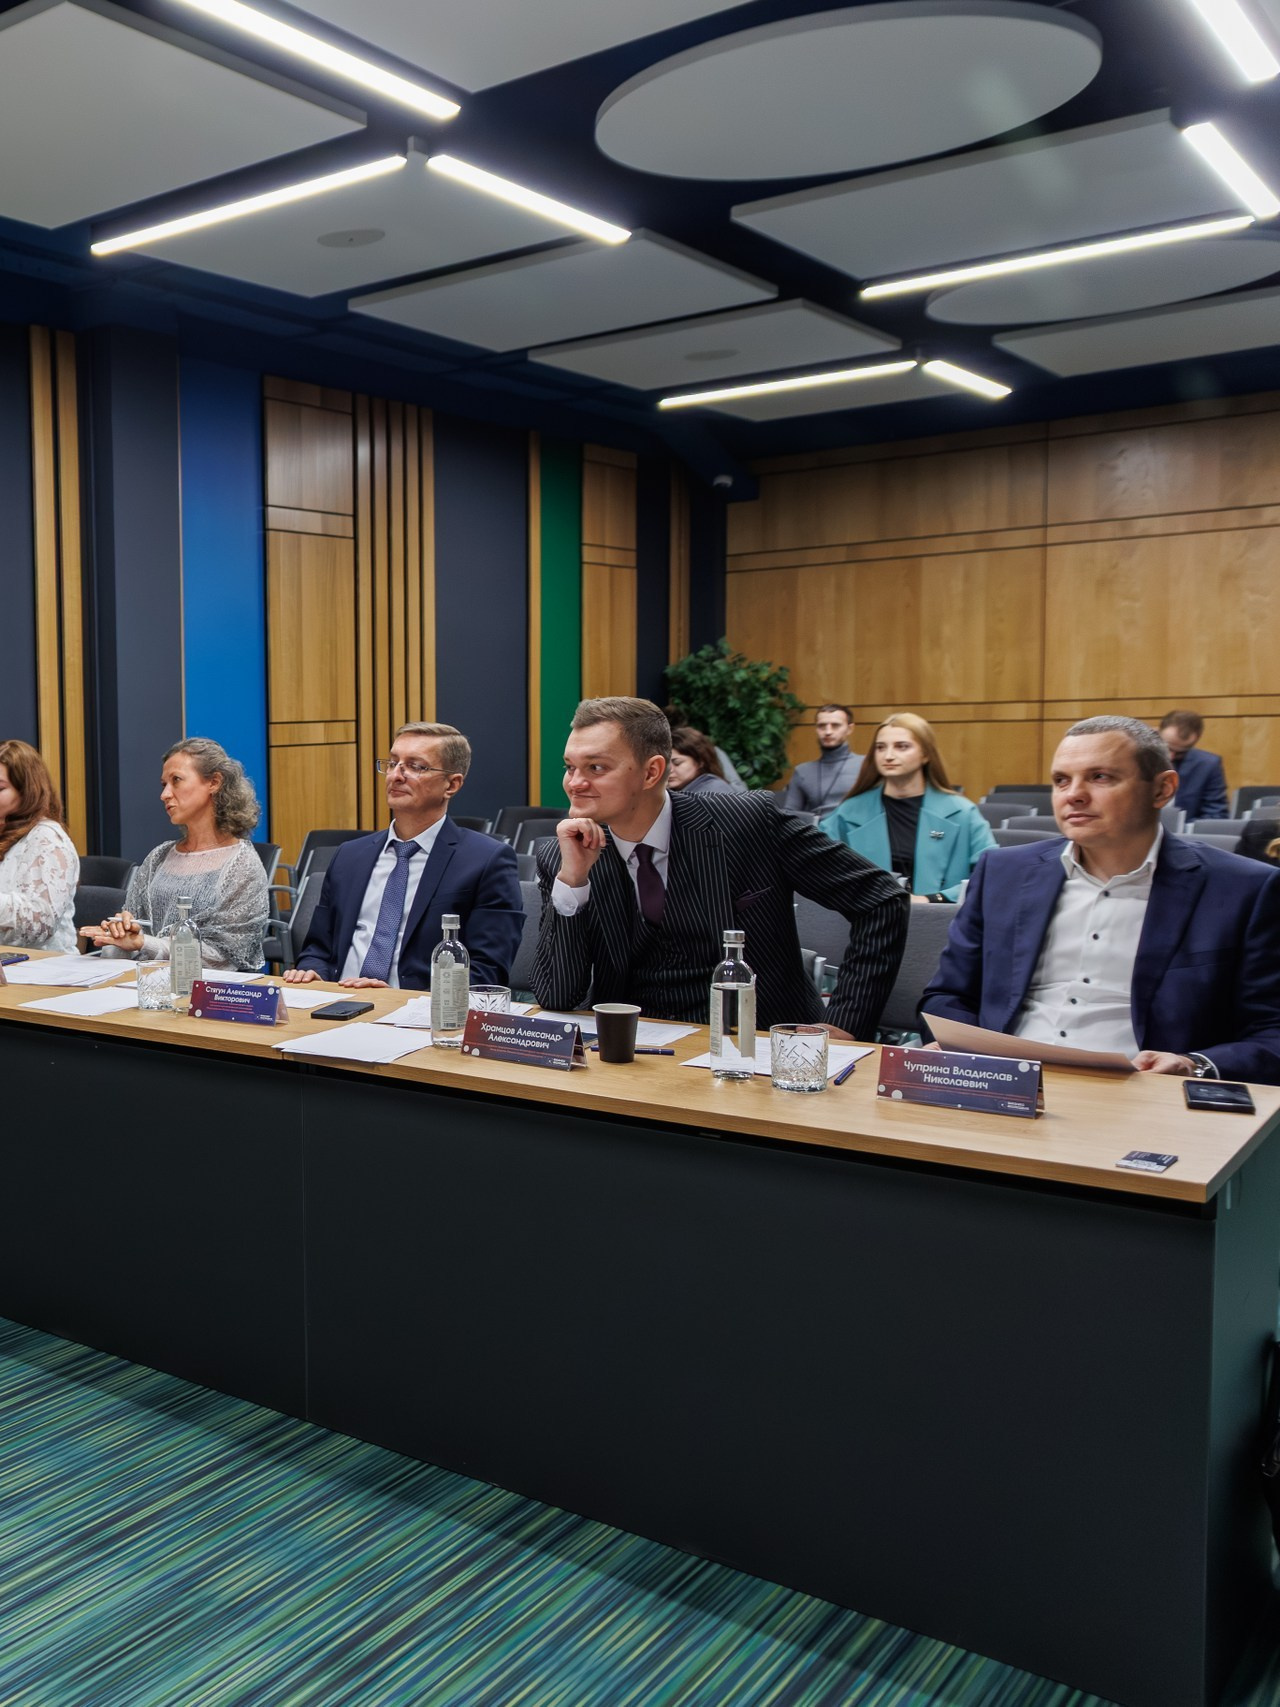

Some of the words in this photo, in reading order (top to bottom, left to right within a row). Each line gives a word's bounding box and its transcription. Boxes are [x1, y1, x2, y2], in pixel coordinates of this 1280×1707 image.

[205, 986, 226, 995] Стягун
[226, 988, 262, 999] Александр
[214, 994, 250, 1004] Викторович
[480, 1022, 515, 1035] Храмцов
[516, 1027, 561, 1042] Александр
[487, 1033, 550, 1049] Александрович
[904, 1060, 950, 1075] Чуприна
[952, 1066, 1013, 1082] Владислав
[923, 1074, 989, 1090] Николаевич
